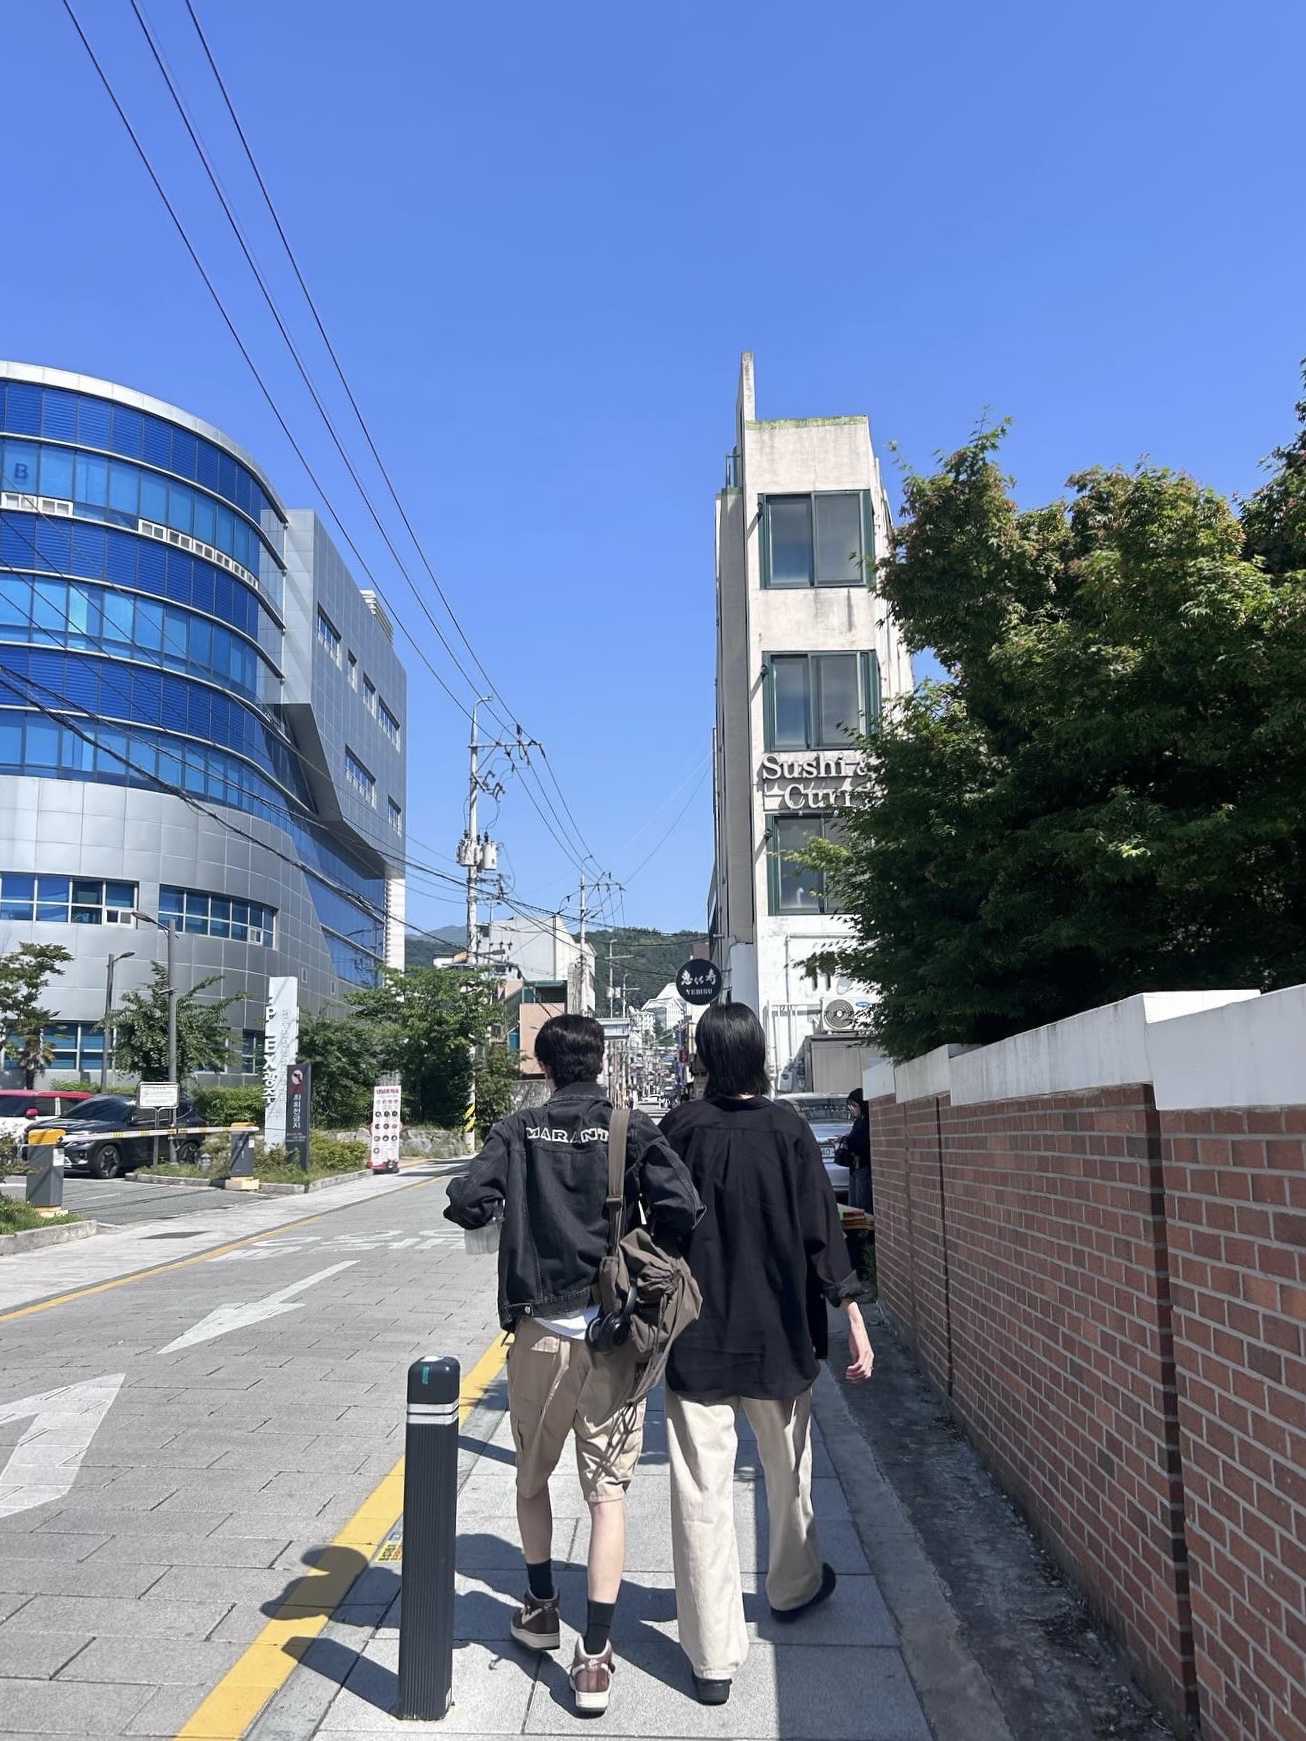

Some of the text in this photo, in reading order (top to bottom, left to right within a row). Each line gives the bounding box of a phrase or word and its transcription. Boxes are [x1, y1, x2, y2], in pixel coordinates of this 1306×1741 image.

[762, 750, 848, 779] Sushi
[784, 783, 871, 810] Curr
[526, 1126, 610, 1144] MARANT
